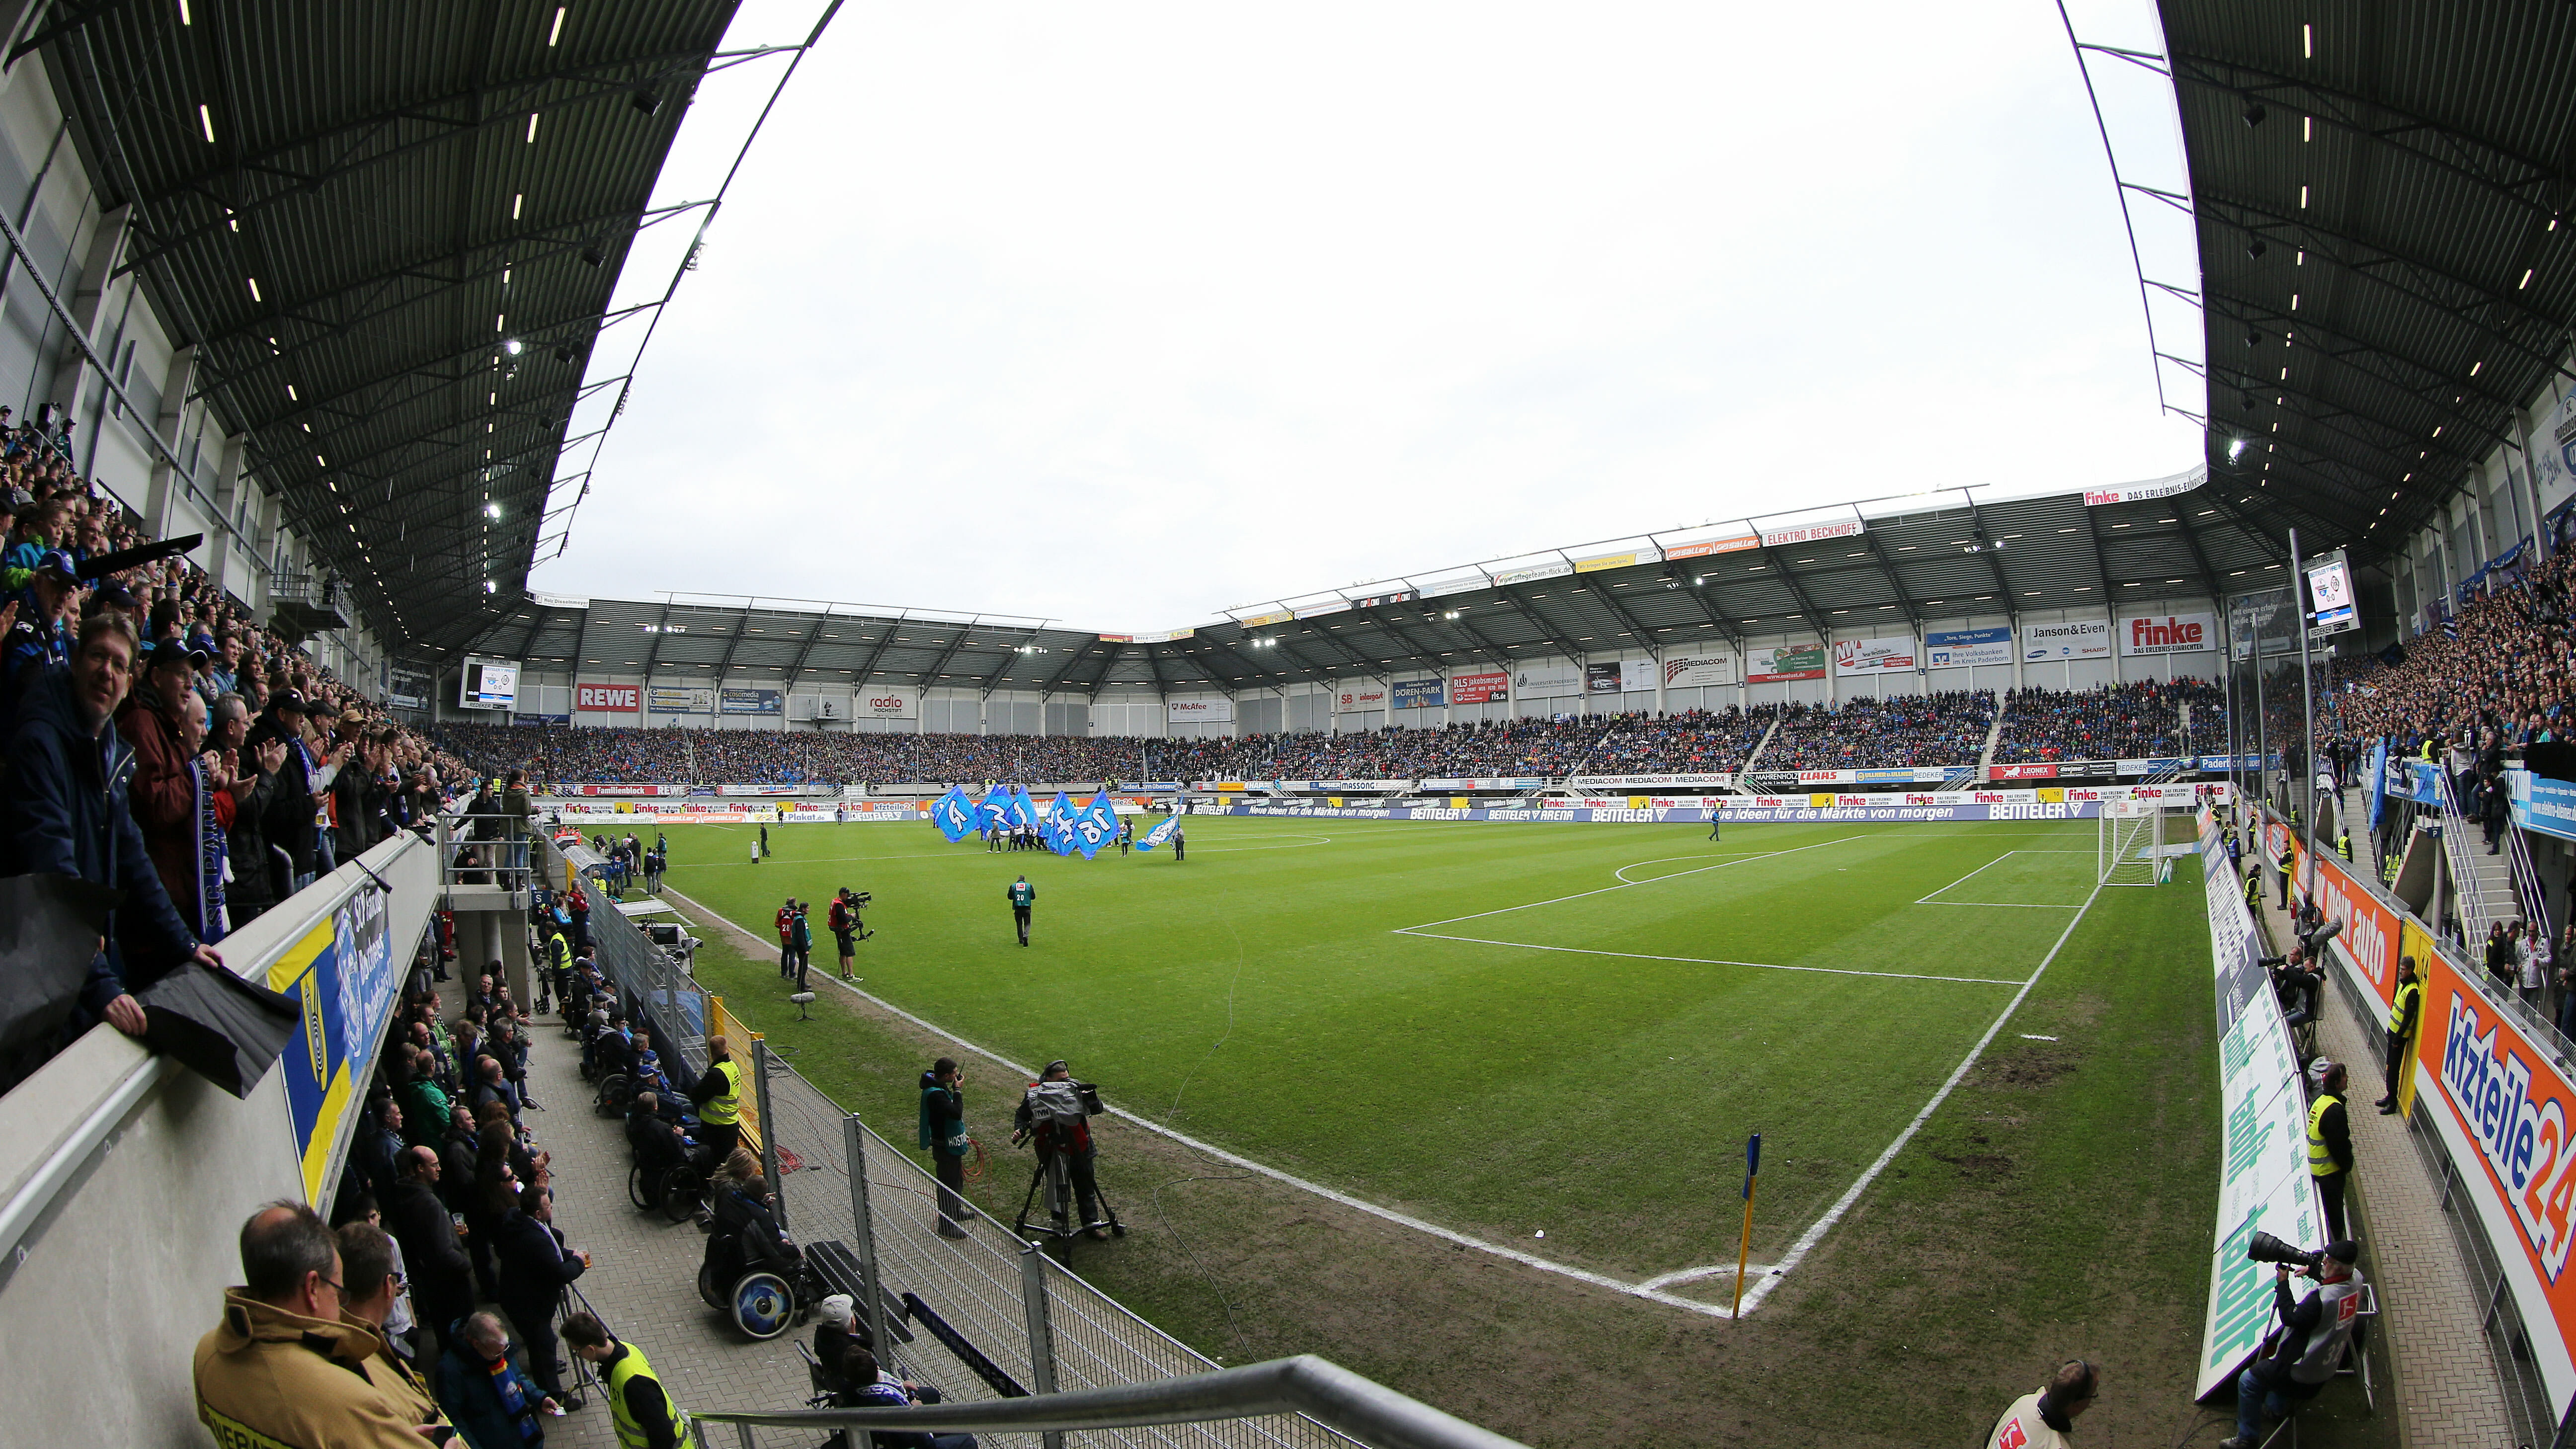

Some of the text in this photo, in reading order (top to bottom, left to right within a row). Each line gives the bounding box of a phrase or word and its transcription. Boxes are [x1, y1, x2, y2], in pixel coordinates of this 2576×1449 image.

[2085, 490, 2143, 505] finke DAS
[1768, 523, 1856, 545] ELEKTRO BECKHOFF
[1499, 566, 1571, 584] www.pflegeteam-flick.de
[1360, 598, 1380, 608] CUP&CINO
[1390, 593, 1411, 604] CUP&CINO
[2132, 617, 2202, 646] finke
[2311, 626, 2332, 636] REDEKER
[2146, 644, 2203, 653] ERLEBNIS-EINRICHTEN
[1684, 658, 1727, 667] MEDIACOM
[1453, 676, 1503, 688] RLS jakobsmeyer
[1395, 686, 1441, 697] DÖREN-PARK
[1491, 692, 1506, 700] rls.de
[580, 688, 637, 707] REWE
[870, 694, 902, 708] radio
[1341, 694, 1353, 704] SB
[1800, 772, 1837, 781] CLAAS
[597, 786, 644, 795] Familienblock
[2069, 789, 2097, 800] finke
[1544, 799, 1565, 807] finke
[1585, 799, 1607, 807] finke
[1651, 798, 1675, 807] finke
[1757, 797, 1782, 806] finke
[1839, 796, 1866, 805] finke
[1975, 792, 2004, 803] finke
[635, 804, 659, 813] finke
[795, 803, 818, 811] finke
[1192, 805, 1225, 815] BENTELER
[1248, 806, 1267, 815] Neue
[1268, 806, 1288, 815] Ideen
[1288, 806, 1300, 815] für
[1302, 806, 1312, 815] die
[1313, 806, 1340, 817] Märkte
[1357, 808, 1390, 818] morgen
[1990, 803, 2066, 820] BENTELER
[1410, 808, 1460, 820] BENTELER
[1488, 810, 1574, 820] BENTELER ARENA
[1591, 808, 1653, 822] BENTELER
[1736, 806, 1954, 821] Ideen für die Märkte von morgen
[205, 885, 222, 928] SC
[2327, 879, 2386, 985] mein auto
[2421, 954, 2428, 985] 14
[2224, 1013, 2259, 1084] taxofit
[2227, 1082, 2275, 1188] taxofit
[2444, 1006, 2576, 1259] kfzteile24
[948, 1133, 964, 1147] HOST
[2296, 1209, 2314, 1247] taxofit
